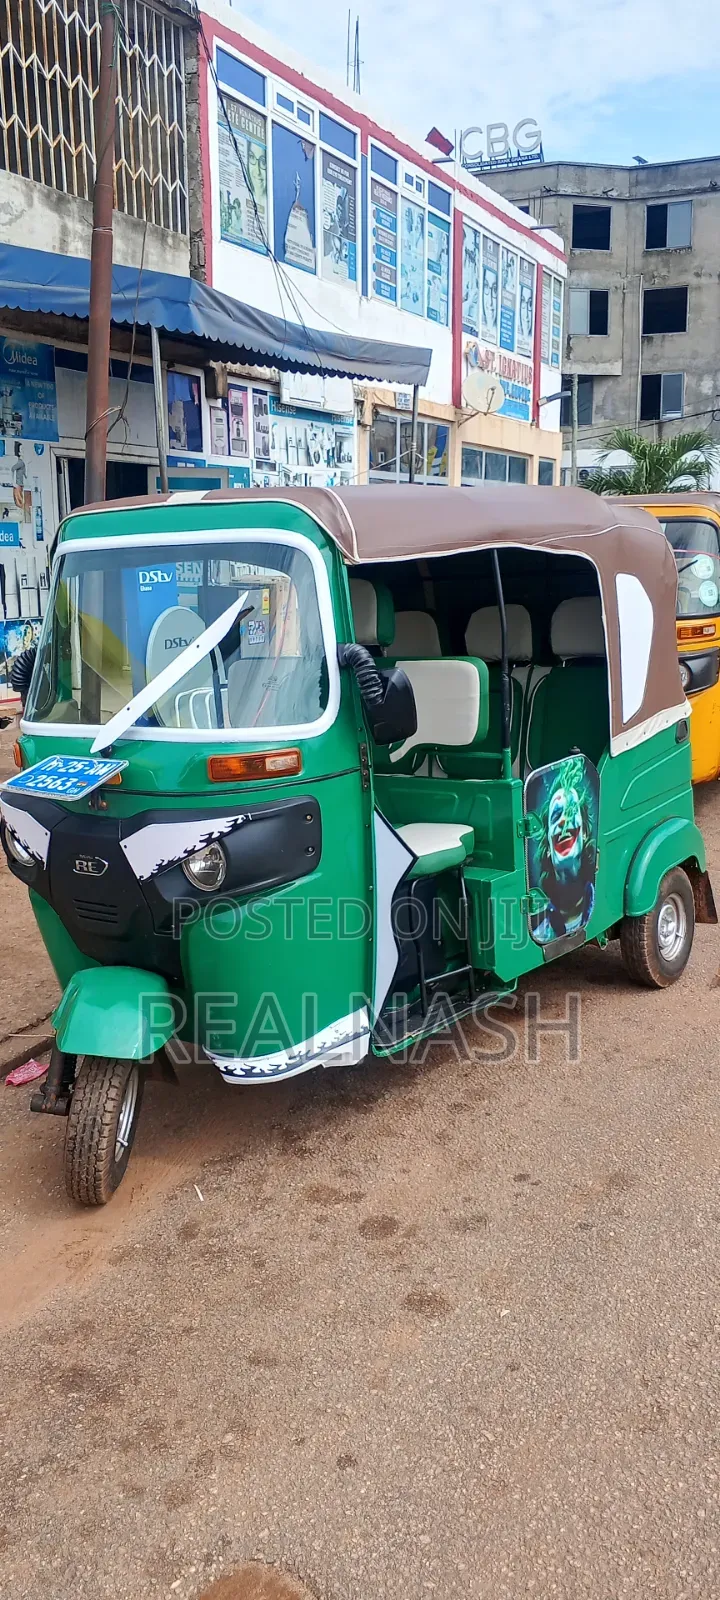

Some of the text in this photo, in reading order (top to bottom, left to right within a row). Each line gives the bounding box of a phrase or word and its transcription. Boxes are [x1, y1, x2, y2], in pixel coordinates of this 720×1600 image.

[241, 116, 265, 140] CENTRE
[460, 118, 542, 160] CBG
[3, 345, 38, 366] Midea
[498, 354, 533, 385] IGNATIUS
[271, 400, 297, 415] Hisense
[138, 570, 173, 584] DStv
[25, 774, 79, 791] 2563
[75, 859, 99, 873] RE
